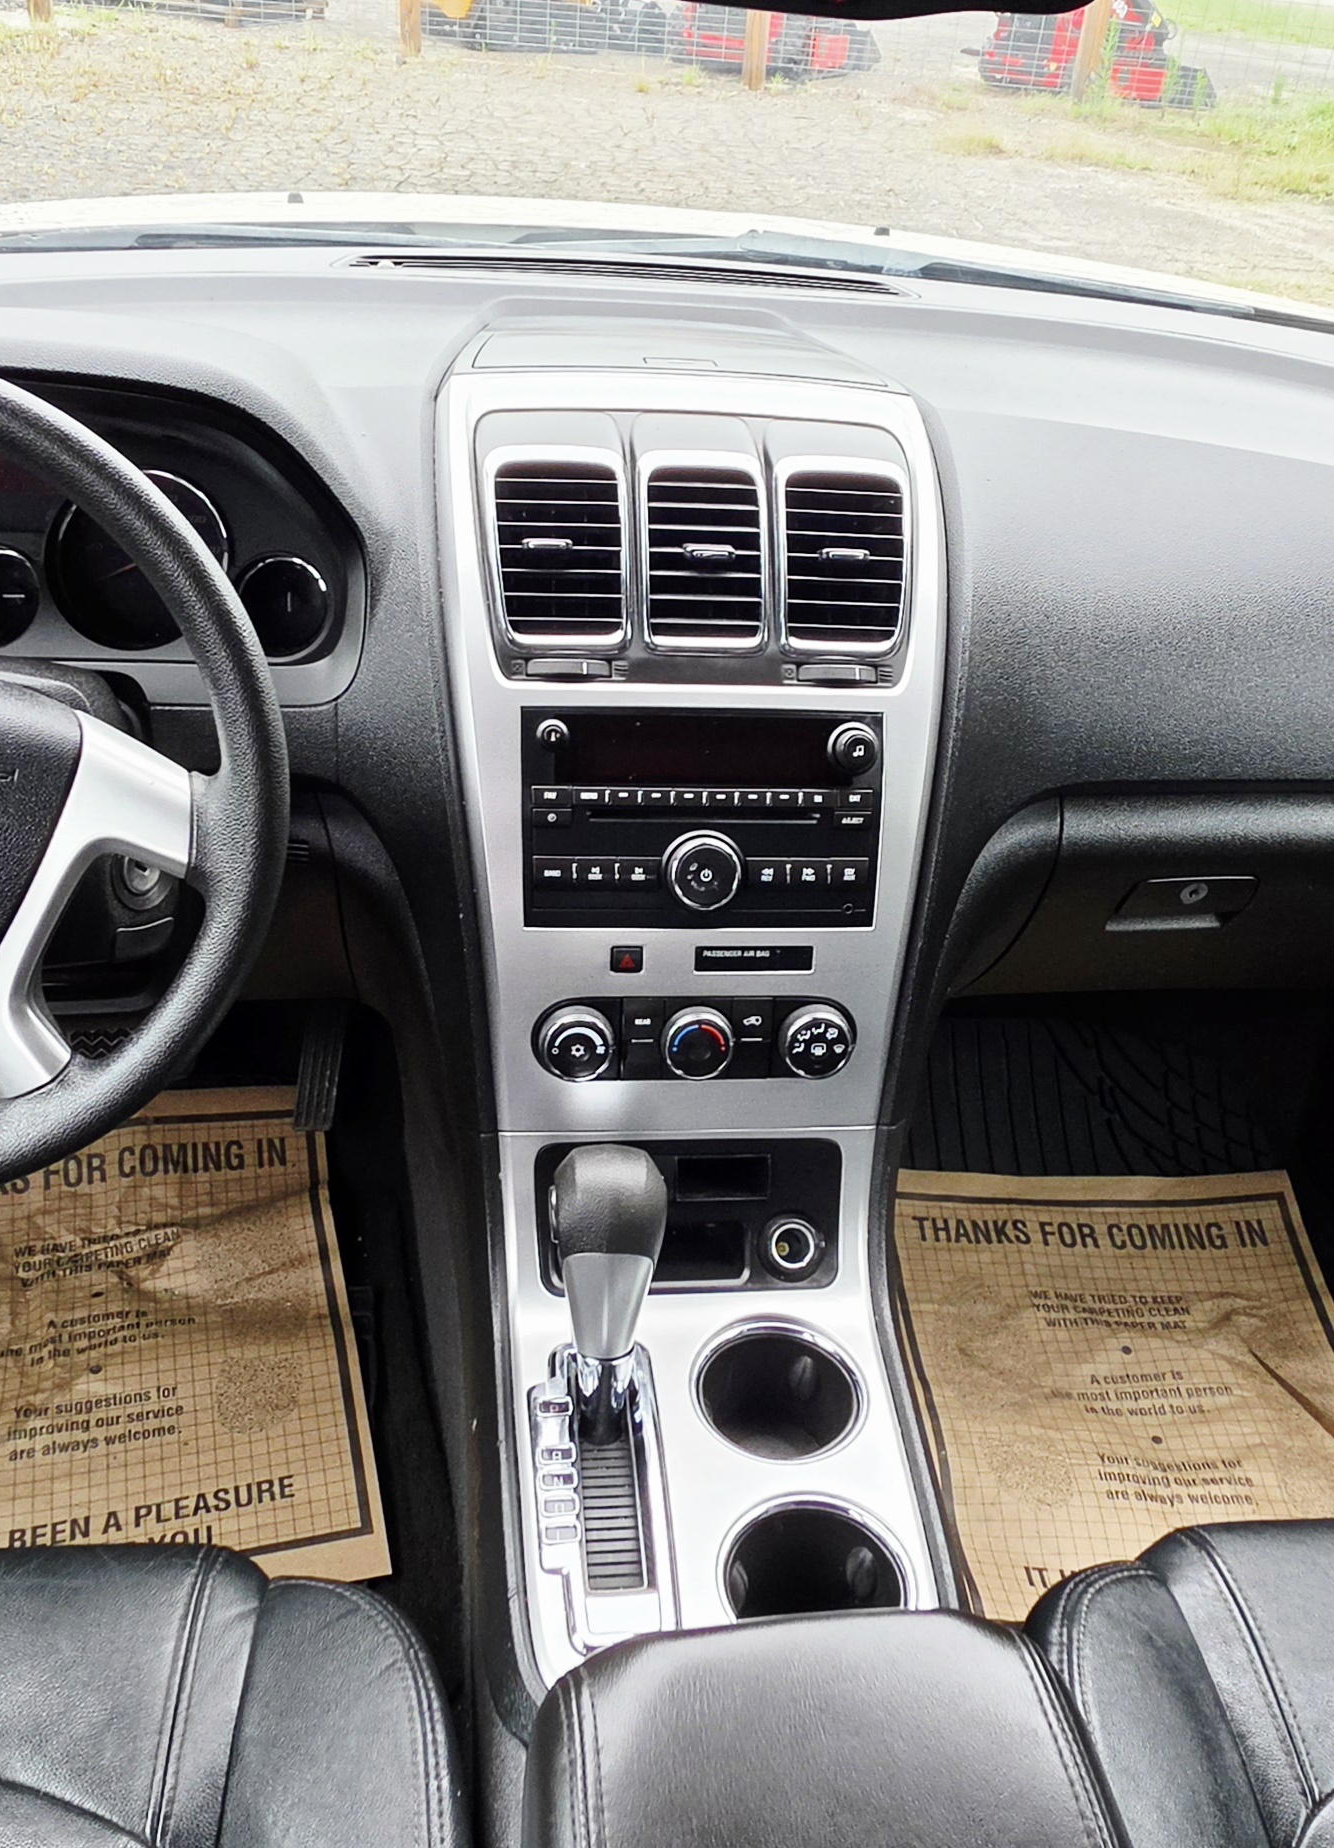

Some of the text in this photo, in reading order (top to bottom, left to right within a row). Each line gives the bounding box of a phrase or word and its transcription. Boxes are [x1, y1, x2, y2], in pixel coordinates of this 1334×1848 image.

[118, 1137, 245, 1179] COMING
[257, 1135, 287, 1169] IN
[912, 1216, 1269, 1251] THANKS FOR COMING IN
[13, 1256, 55, 1274] YOUR
[137, 1228, 180, 1251] CLEAN
[14, 1244, 36, 1258] WE
[41, 1239, 79, 1255] HAVE
[61, 1263, 94, 1279] THIS
[97, 1257, 143, 1271] PAPER
[1030, 1290, 1183, 1305] WE HAVE TRIED TO KEEP
[47, 1308, 148, 1330] A customer is
[1033, 1303, 1191, 1318] YOUR CARPETING CLEAN
[1044, 1317, 1187, 1331] WITH THIS PAPER MAT
[28, 1335, 64, 1354] most
[67, 1322, 141, 1345] important
[145, 1317, 197, 1331] person
[30, 1331, 167, 1368] in the world to us.
[1090, 1370, 1184, 1386] A customer is
[13, 1384, 178, 1421] Your suggestions for
[1077, 1388, 1111, 1401] most
[1115, 1386, 1182, 1405] important
[1186, 1385, 1233, 1402] person
[1085, 1403, 1211, 1418] in the world to us.
[7, 1403, 184, 1442] improving our service
[8, 1424, 183, 1462] are always welcome.
[1097, 1452, 1243, 1474] Your suggestions for
[1098, 1469, 1254, 1490] improving our service
[1106, 1489, 1259, 1508] are always welcome.
[9, 1516, 90, 1549] BEEN
[101, 1511, 123, 1535] A
[134, 1474, 296, 1527] PLEASURE
[1024, 1566, 1048, 1588] IT
